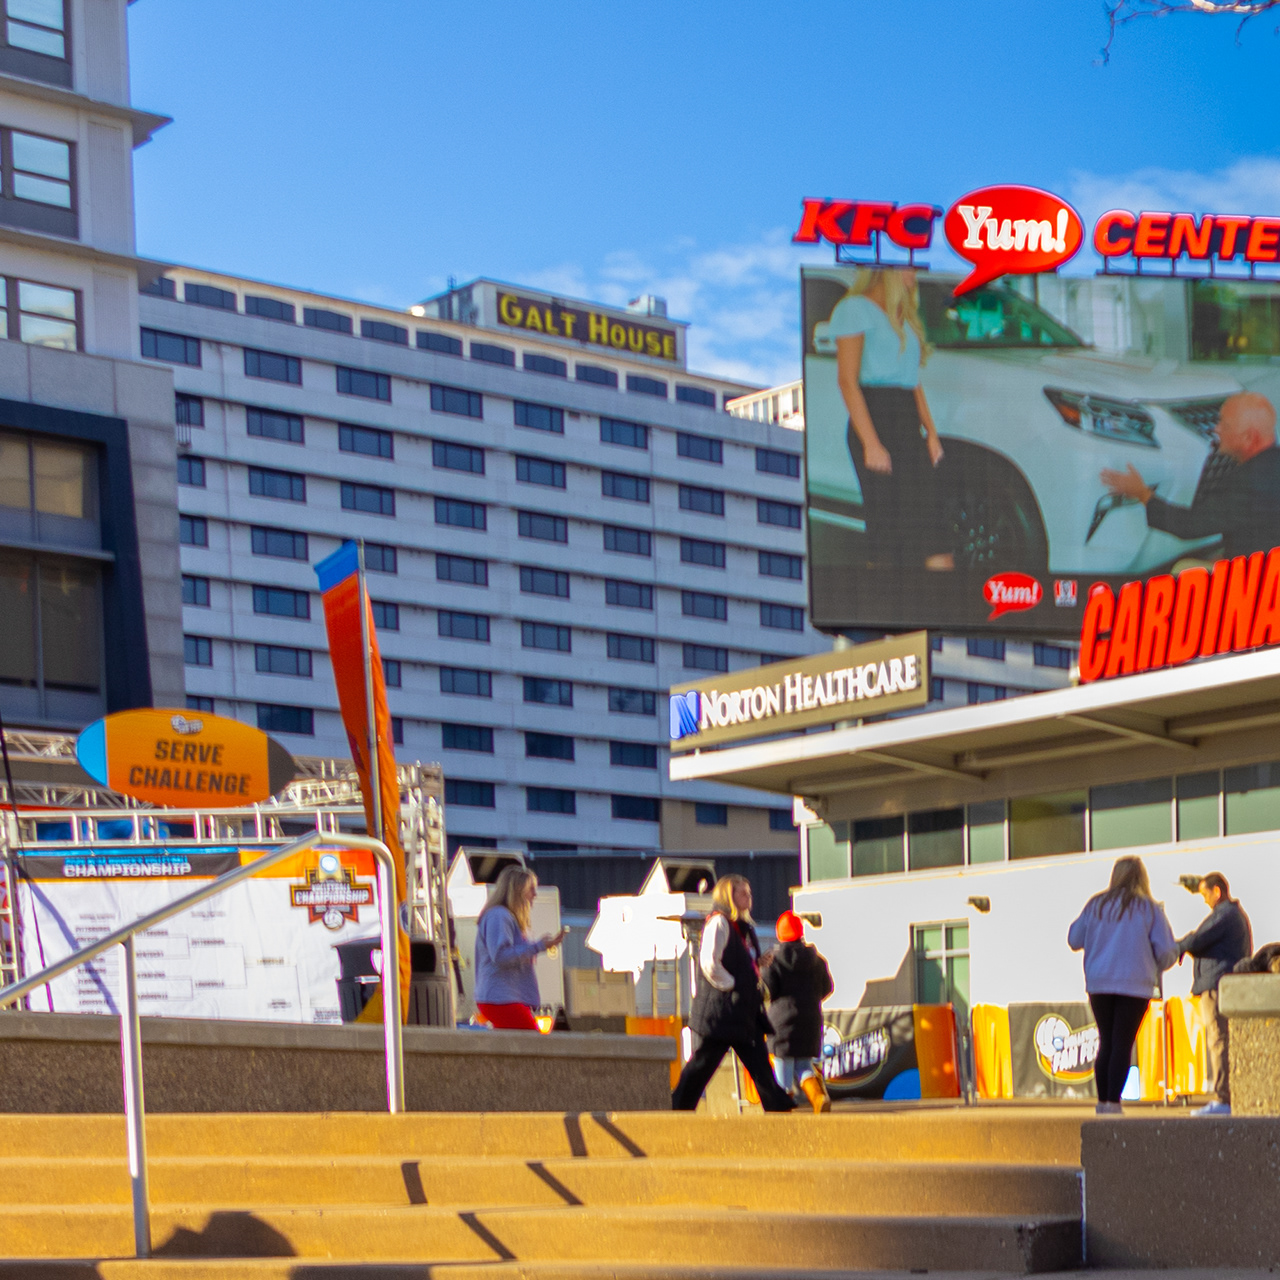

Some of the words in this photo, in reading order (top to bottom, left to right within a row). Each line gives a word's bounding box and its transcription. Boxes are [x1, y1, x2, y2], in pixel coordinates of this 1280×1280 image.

[792, 197, 942, 249] KFC
[958, 204, 1069, 253] Yum!
[500, 294, 576, 338] GALT
[588, 311, 676, 360] HOUSE
[988, 580, 1039, 605] Yum!
[700, 683, 781, 730] NORTON
[784, 654, 918, 714] HEALTHCARE
[155, 738, 224, 766] SERVE
[128, 764, 252, 797] CHALLENGE
[63, 863, 192, 878] CHAMPIONSHIP
[295, 889, 369, 904] CHAMPIONSHIP
